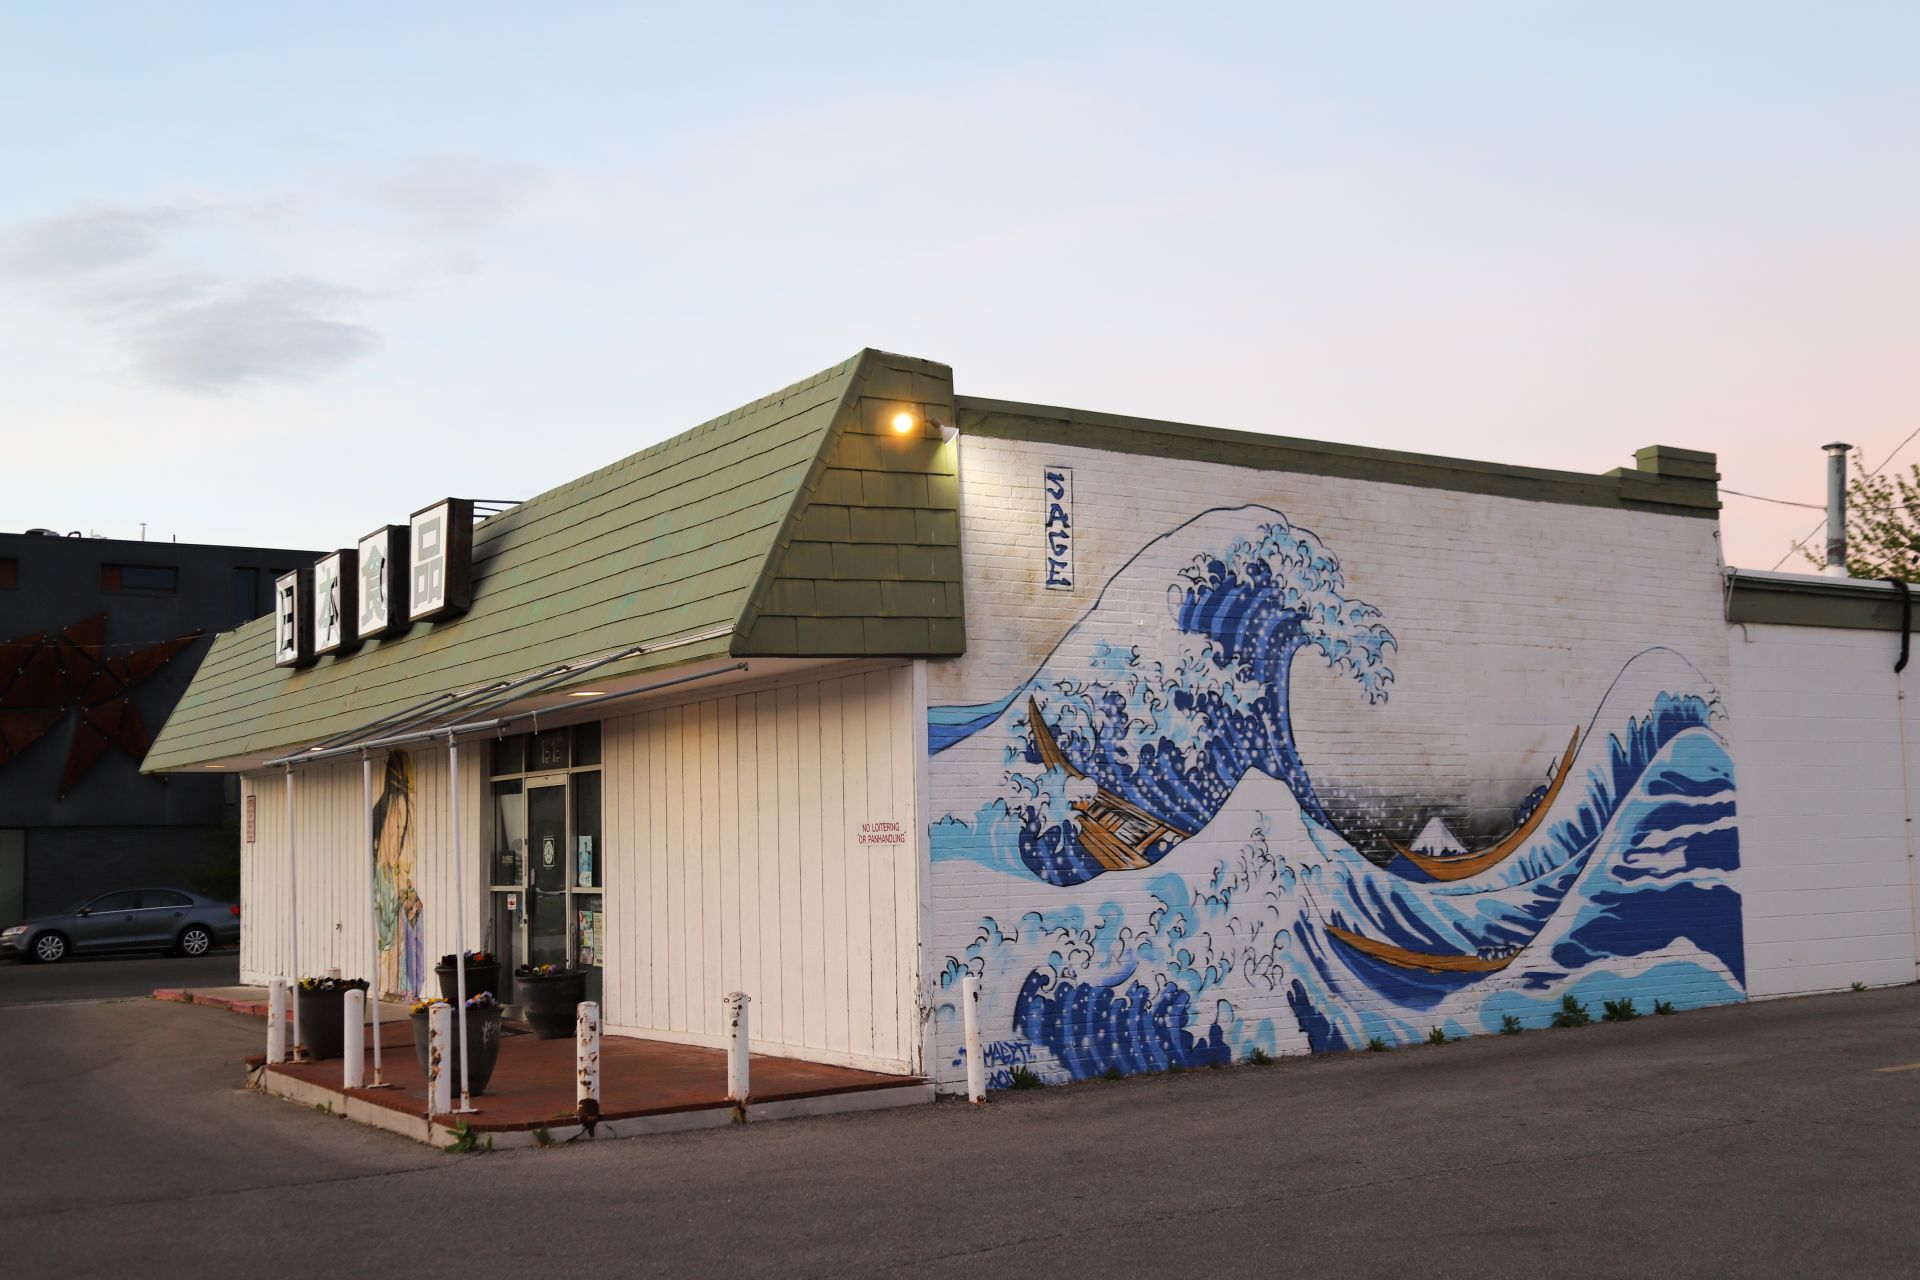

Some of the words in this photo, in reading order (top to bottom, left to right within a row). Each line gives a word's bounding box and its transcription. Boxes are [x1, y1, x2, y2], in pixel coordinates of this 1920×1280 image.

[1045, 471, 1072, 586] SAGE
[862, 823, 871, 833] NO
[872, 822, 900, 832] LOITERING
[858, 834, 867, 844] OR
[868, 833, 905, 844] PANHANDLING
